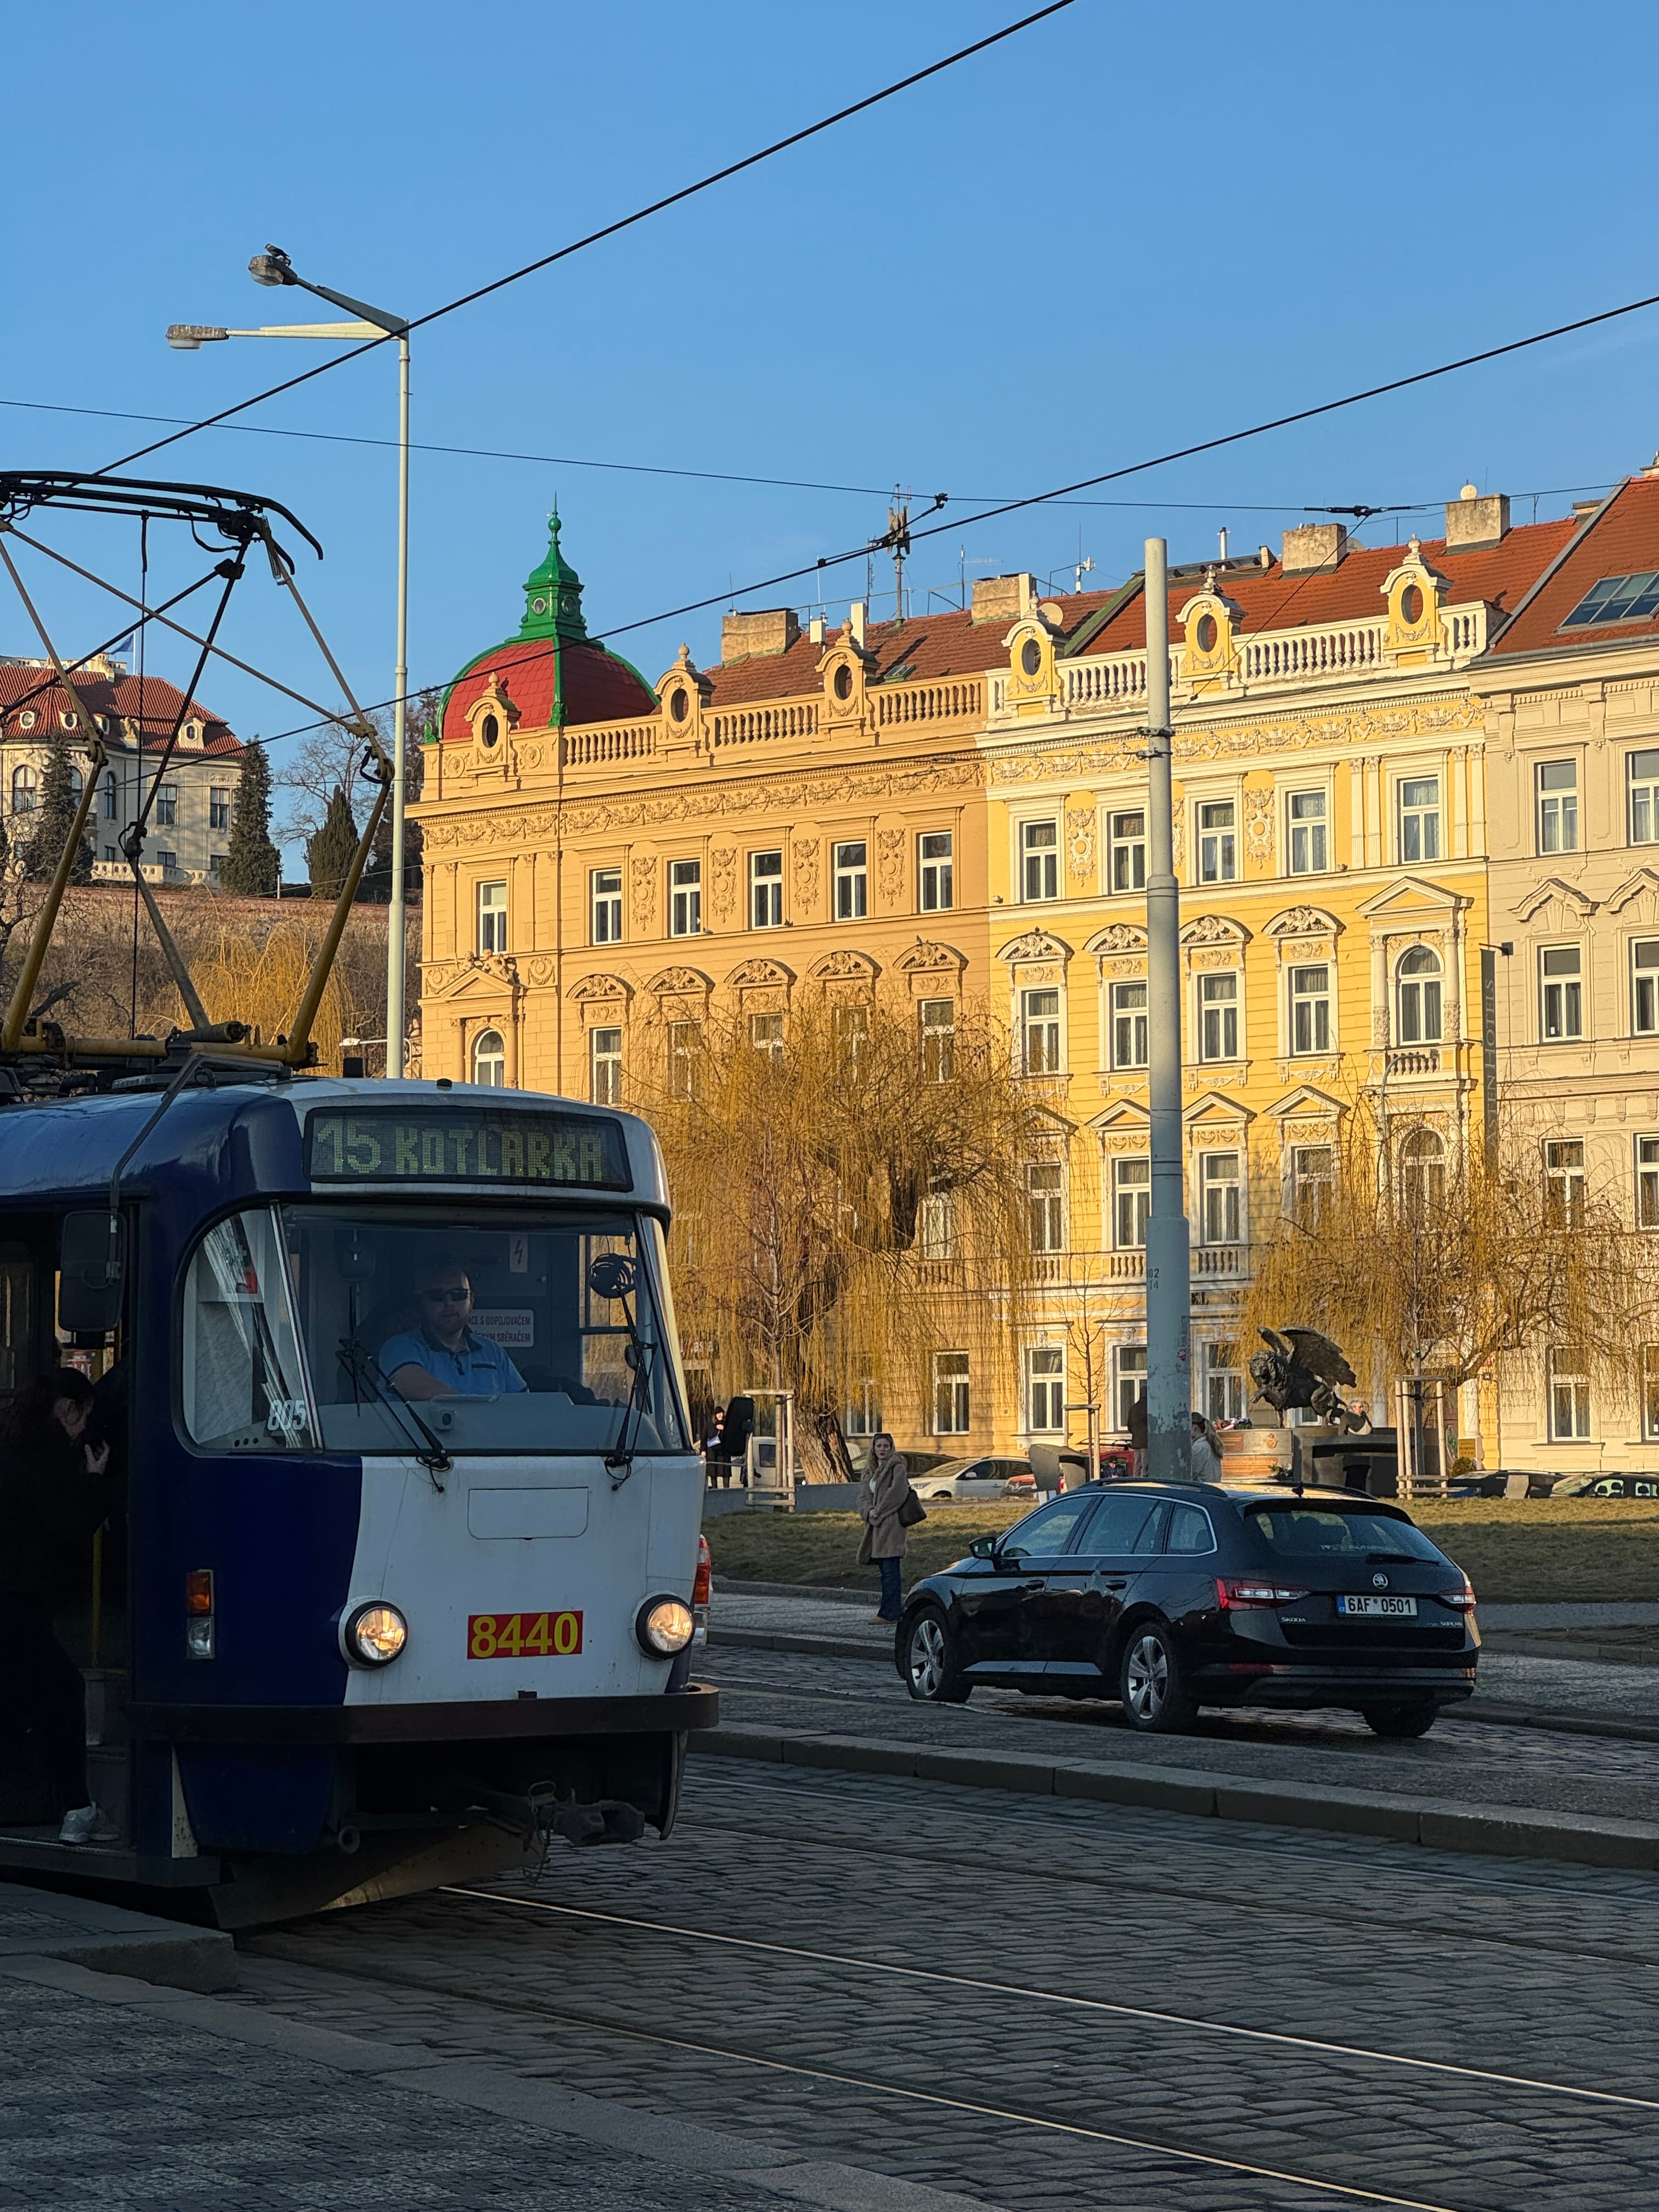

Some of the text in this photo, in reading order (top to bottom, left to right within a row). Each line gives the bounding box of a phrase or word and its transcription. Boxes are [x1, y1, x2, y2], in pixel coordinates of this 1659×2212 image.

[1485, 979, 1495, 1069] HOTELS
[317, 1119, 381, 1173] 15
[486, 1314, 531, 1325] ODPOJOVAČEM
[496, 1330, 531, 1342] SBĚRAČEM
[267, 1400, 306, 1431] 805
[1347, 1597, 1371, 1612] 6AF
[1381, 1598, 1412, 1613] 0501
[471, 1612, 578, 1657] 8440
